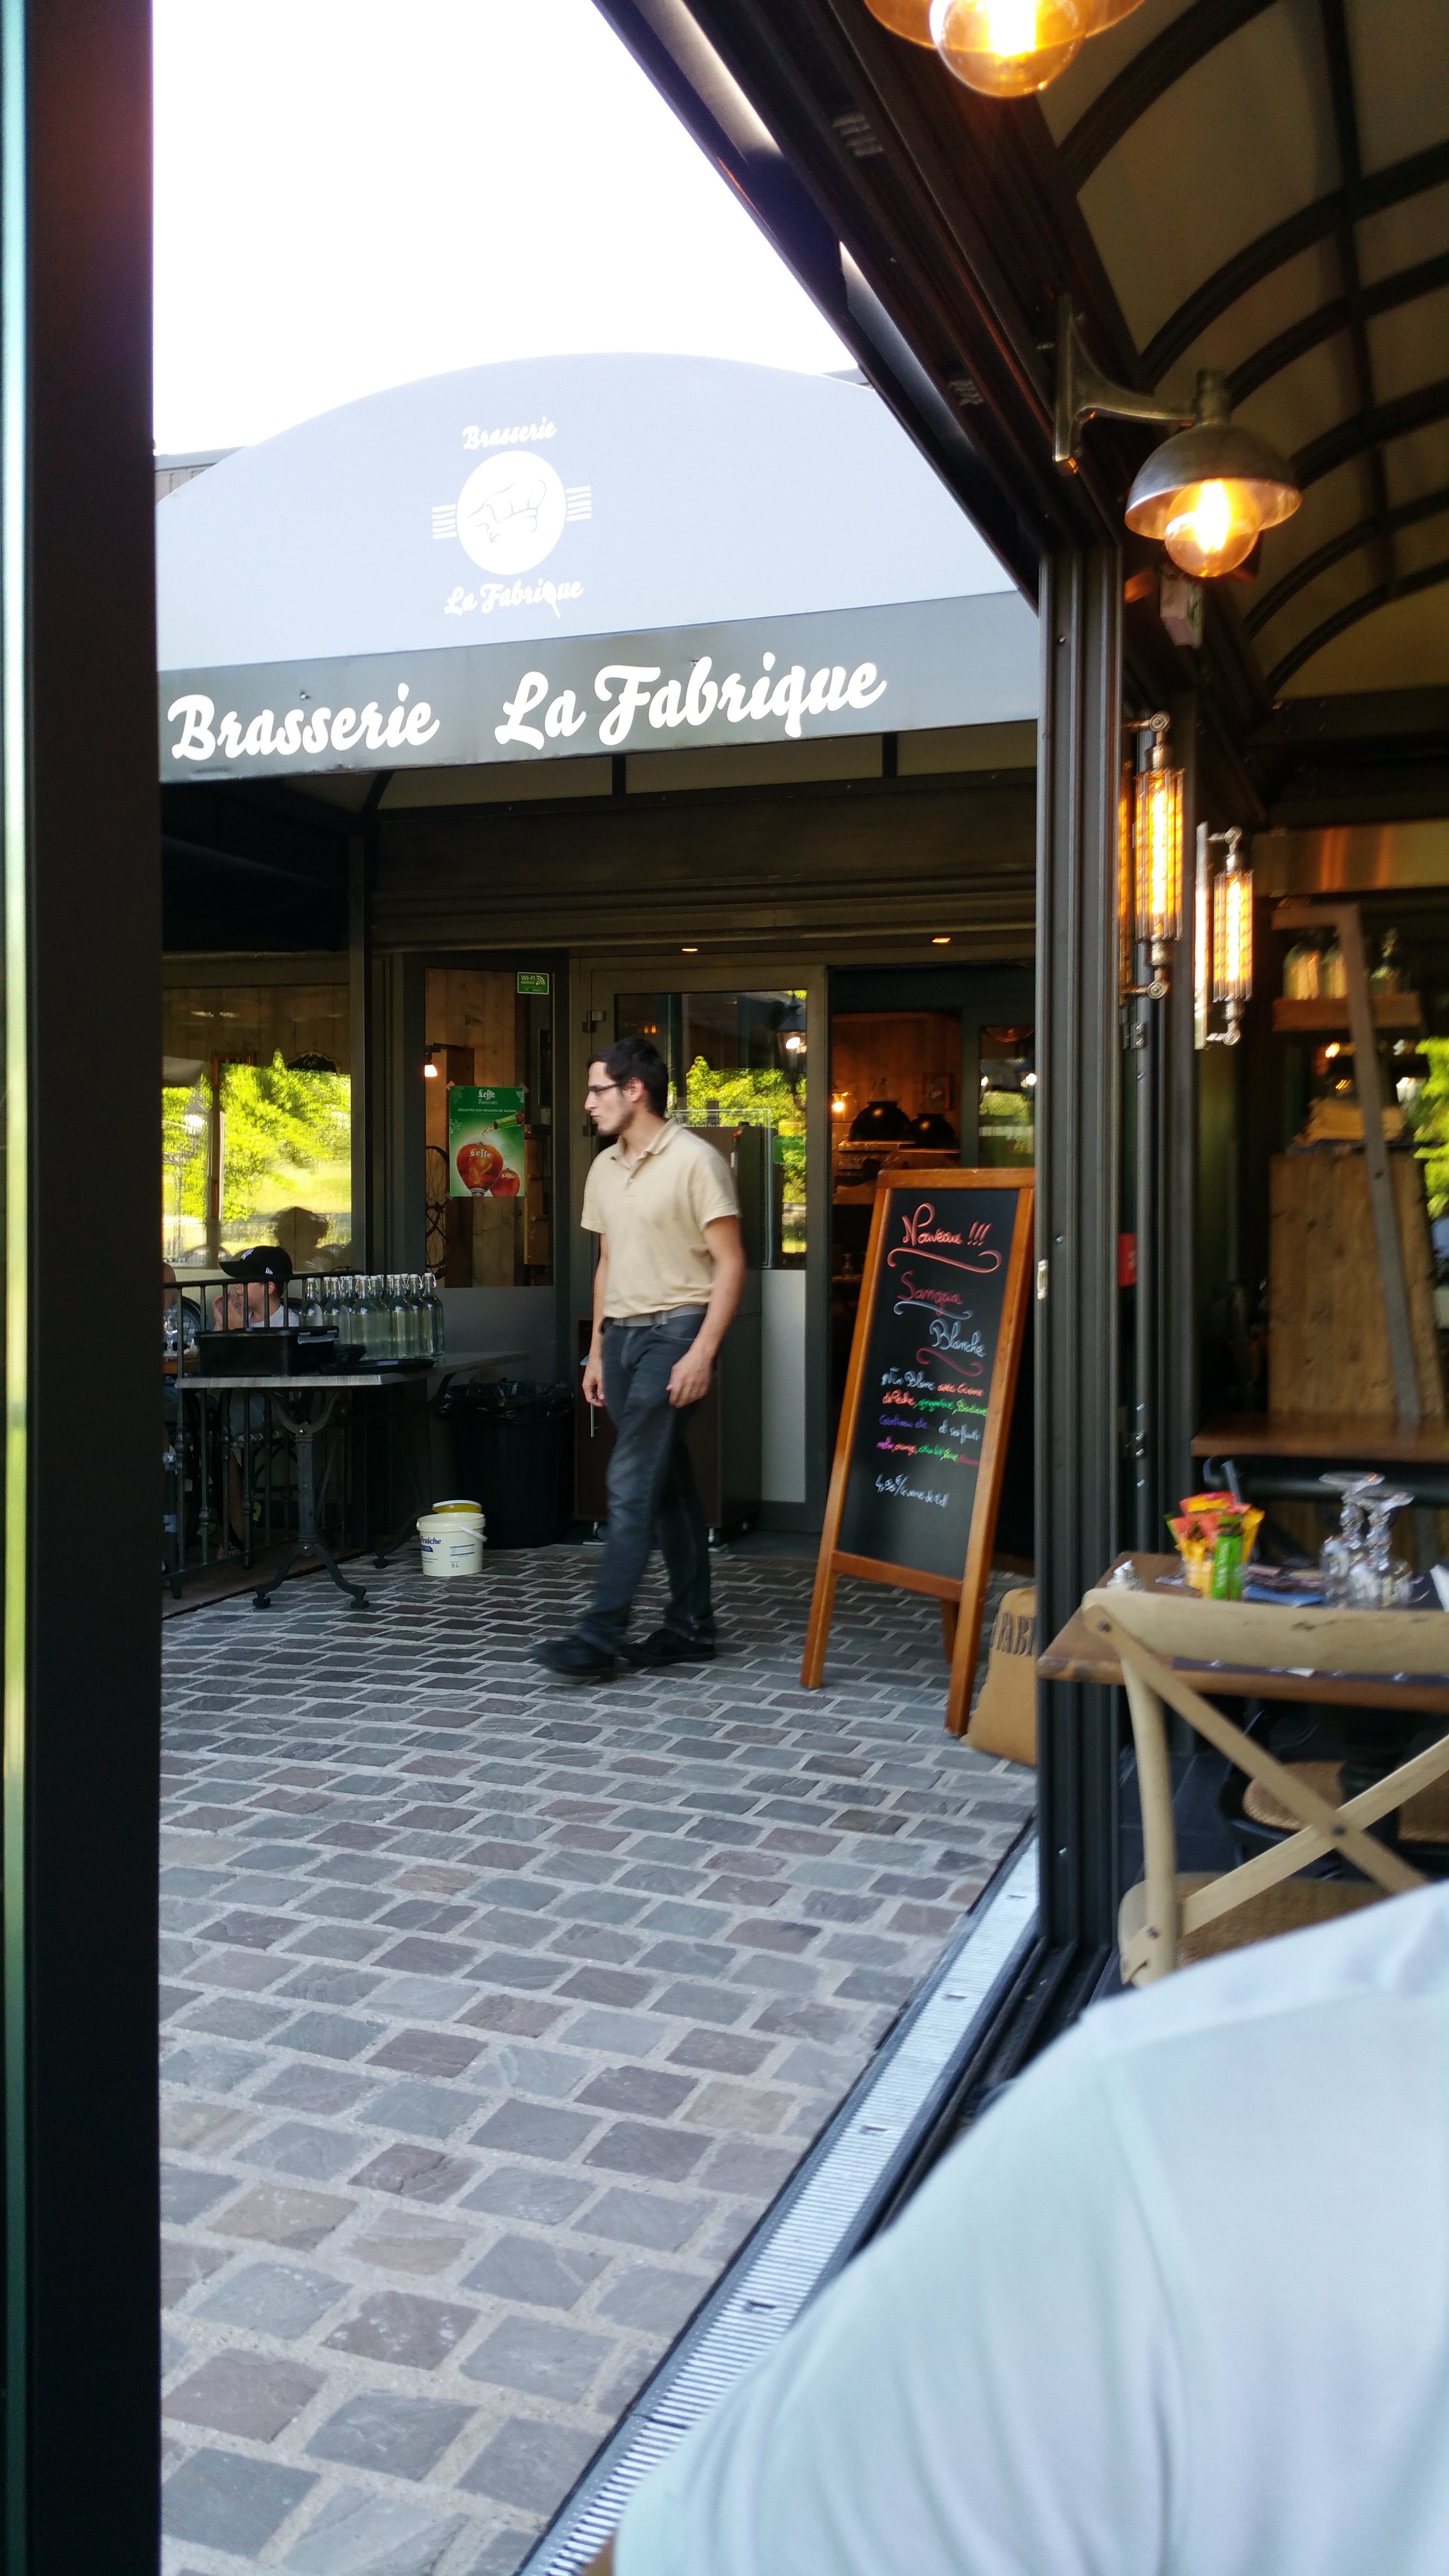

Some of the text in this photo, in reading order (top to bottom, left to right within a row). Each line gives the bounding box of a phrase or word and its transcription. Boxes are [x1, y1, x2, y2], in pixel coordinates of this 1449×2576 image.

[462, 417, 557, 449] Brasserie
[444, 578, 584, 619] La Fabrique
[167, 651, 887, 761] Brasserie La Fabrique
[478, 1089, 495, 1100] Leffe
[468, 1148, 492, 1159] Leffe
[929, 1318, 986, 1357] Blanche
[904, 1370, 935, 1390] Blanc
